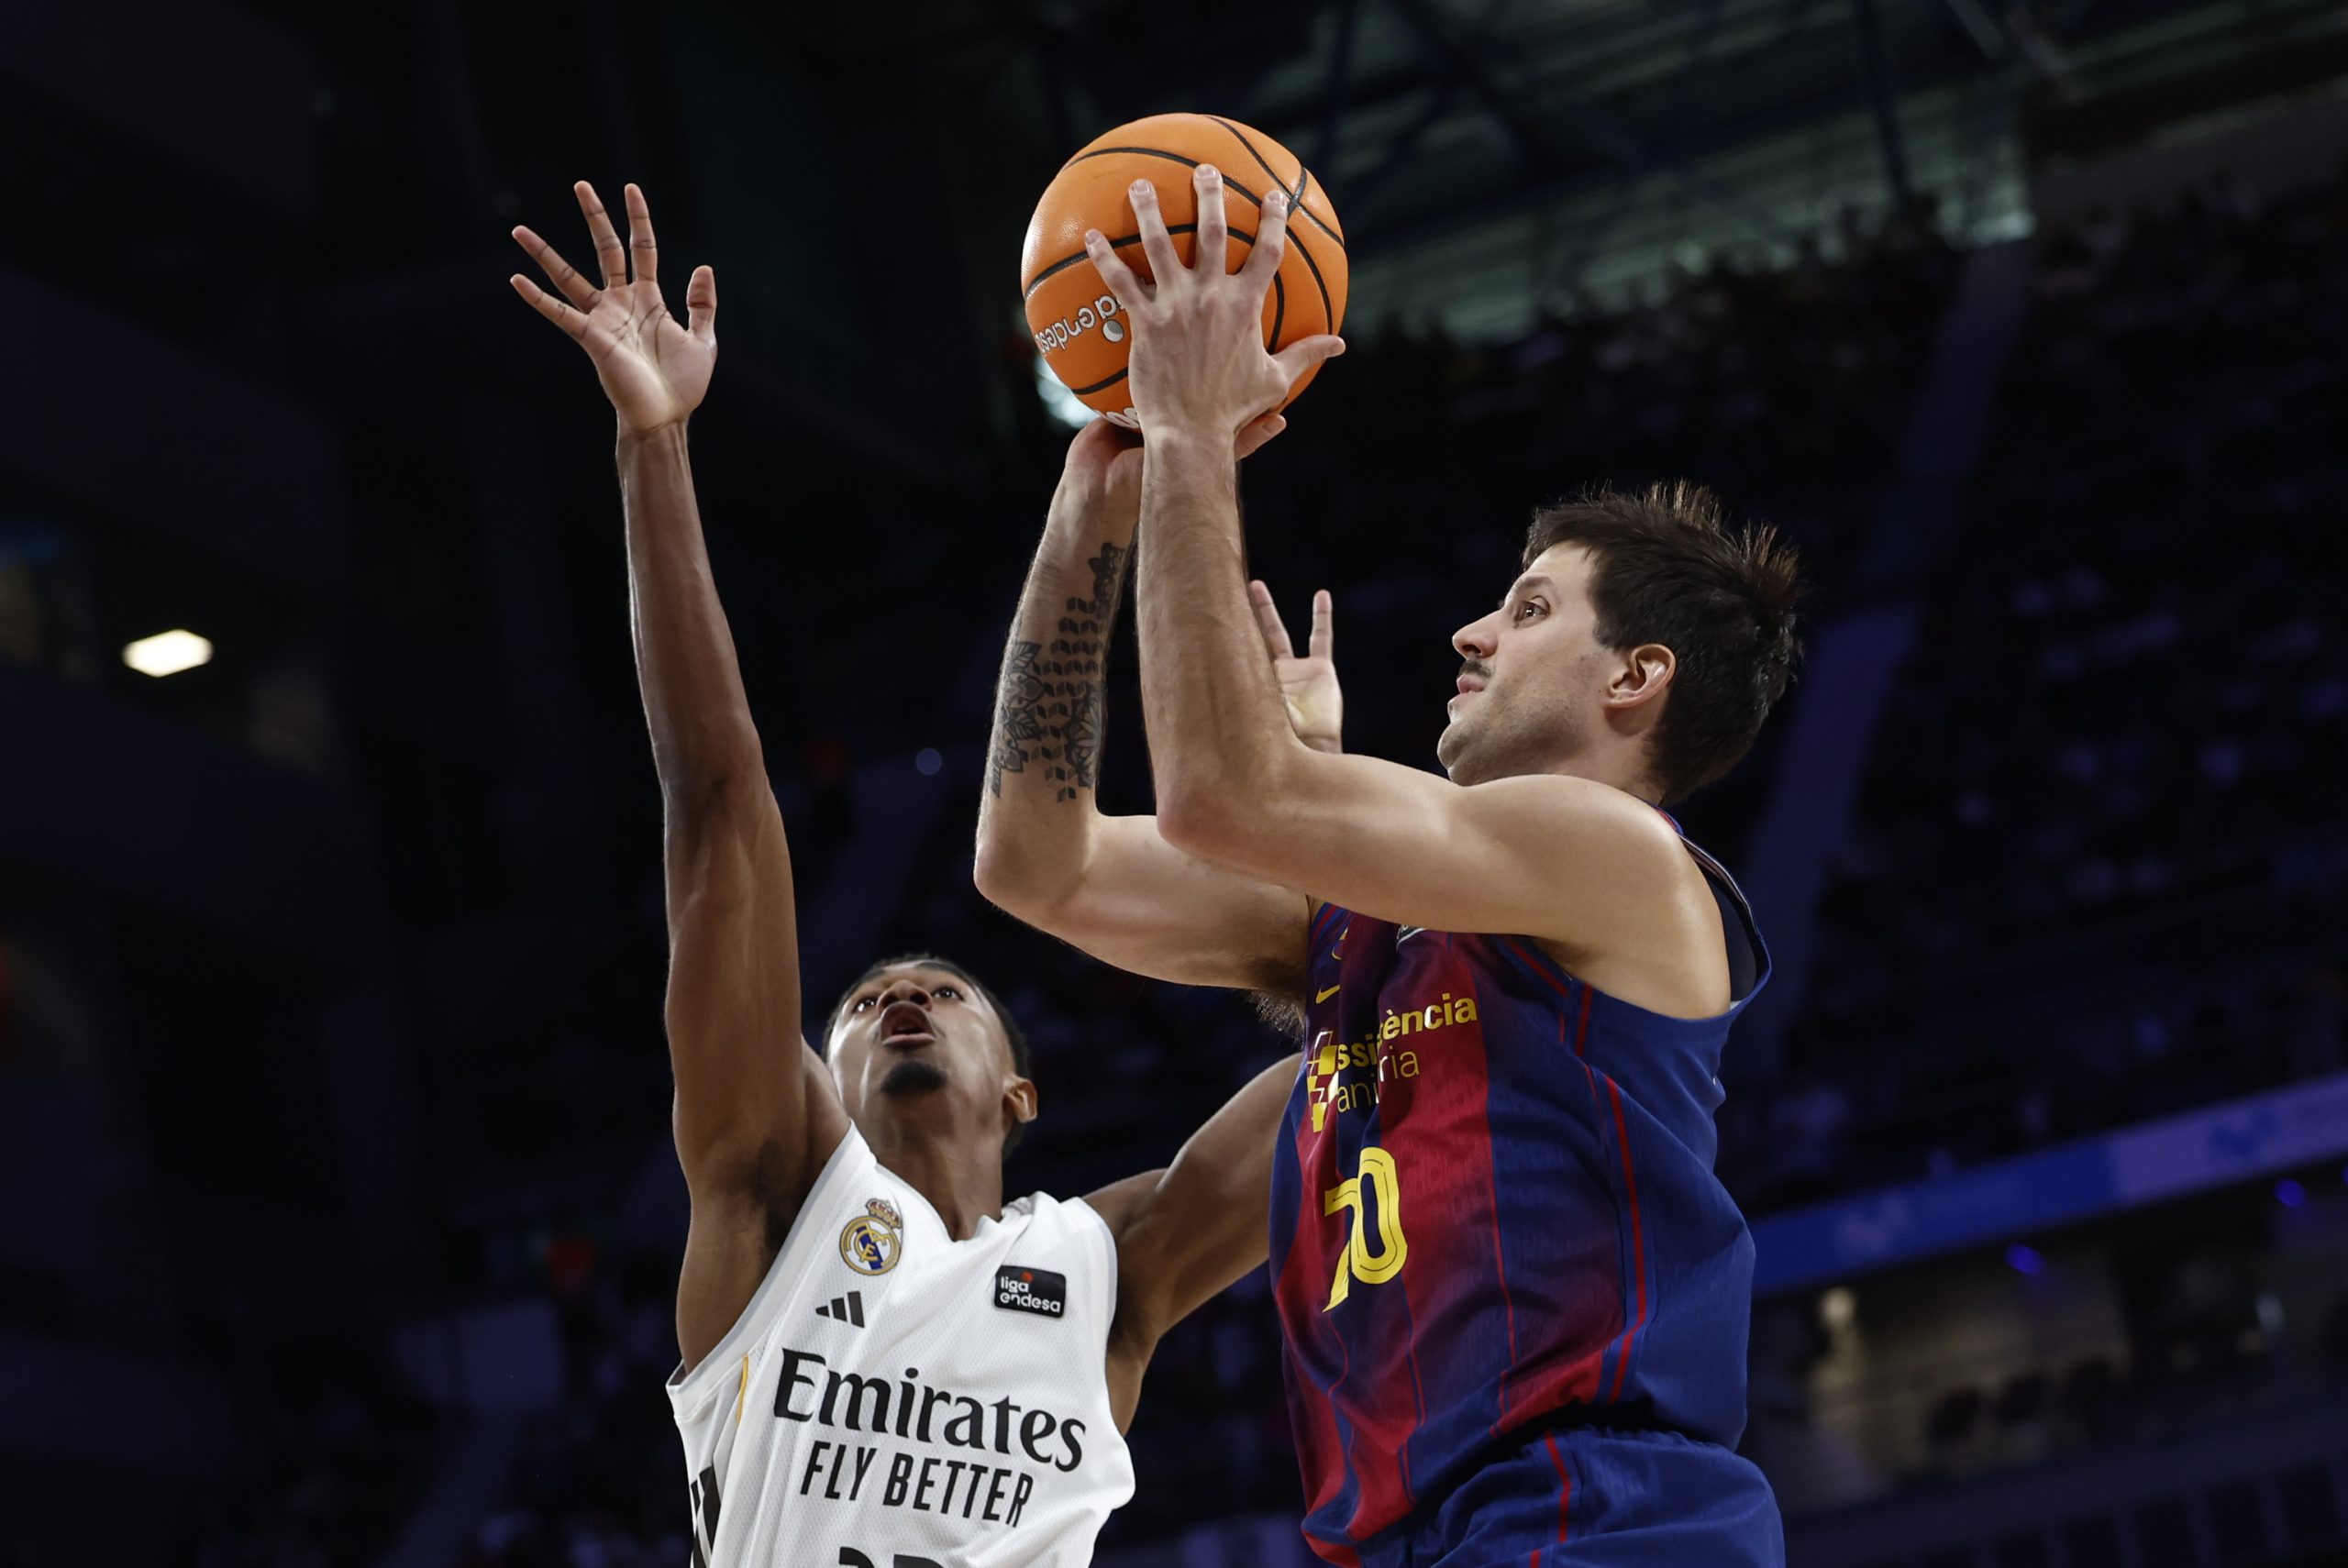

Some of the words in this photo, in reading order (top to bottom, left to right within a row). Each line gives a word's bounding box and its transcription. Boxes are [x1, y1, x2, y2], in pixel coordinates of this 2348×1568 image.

[999, 1292, 1061, 1313] endesa
[1000, 1275, 1029, 1294] liga
[772, 1347, 1087, 1473] Emirates
[800, 1440, 878, 1501] FLY
[882, 1452, 1035, 1528] BETTER
